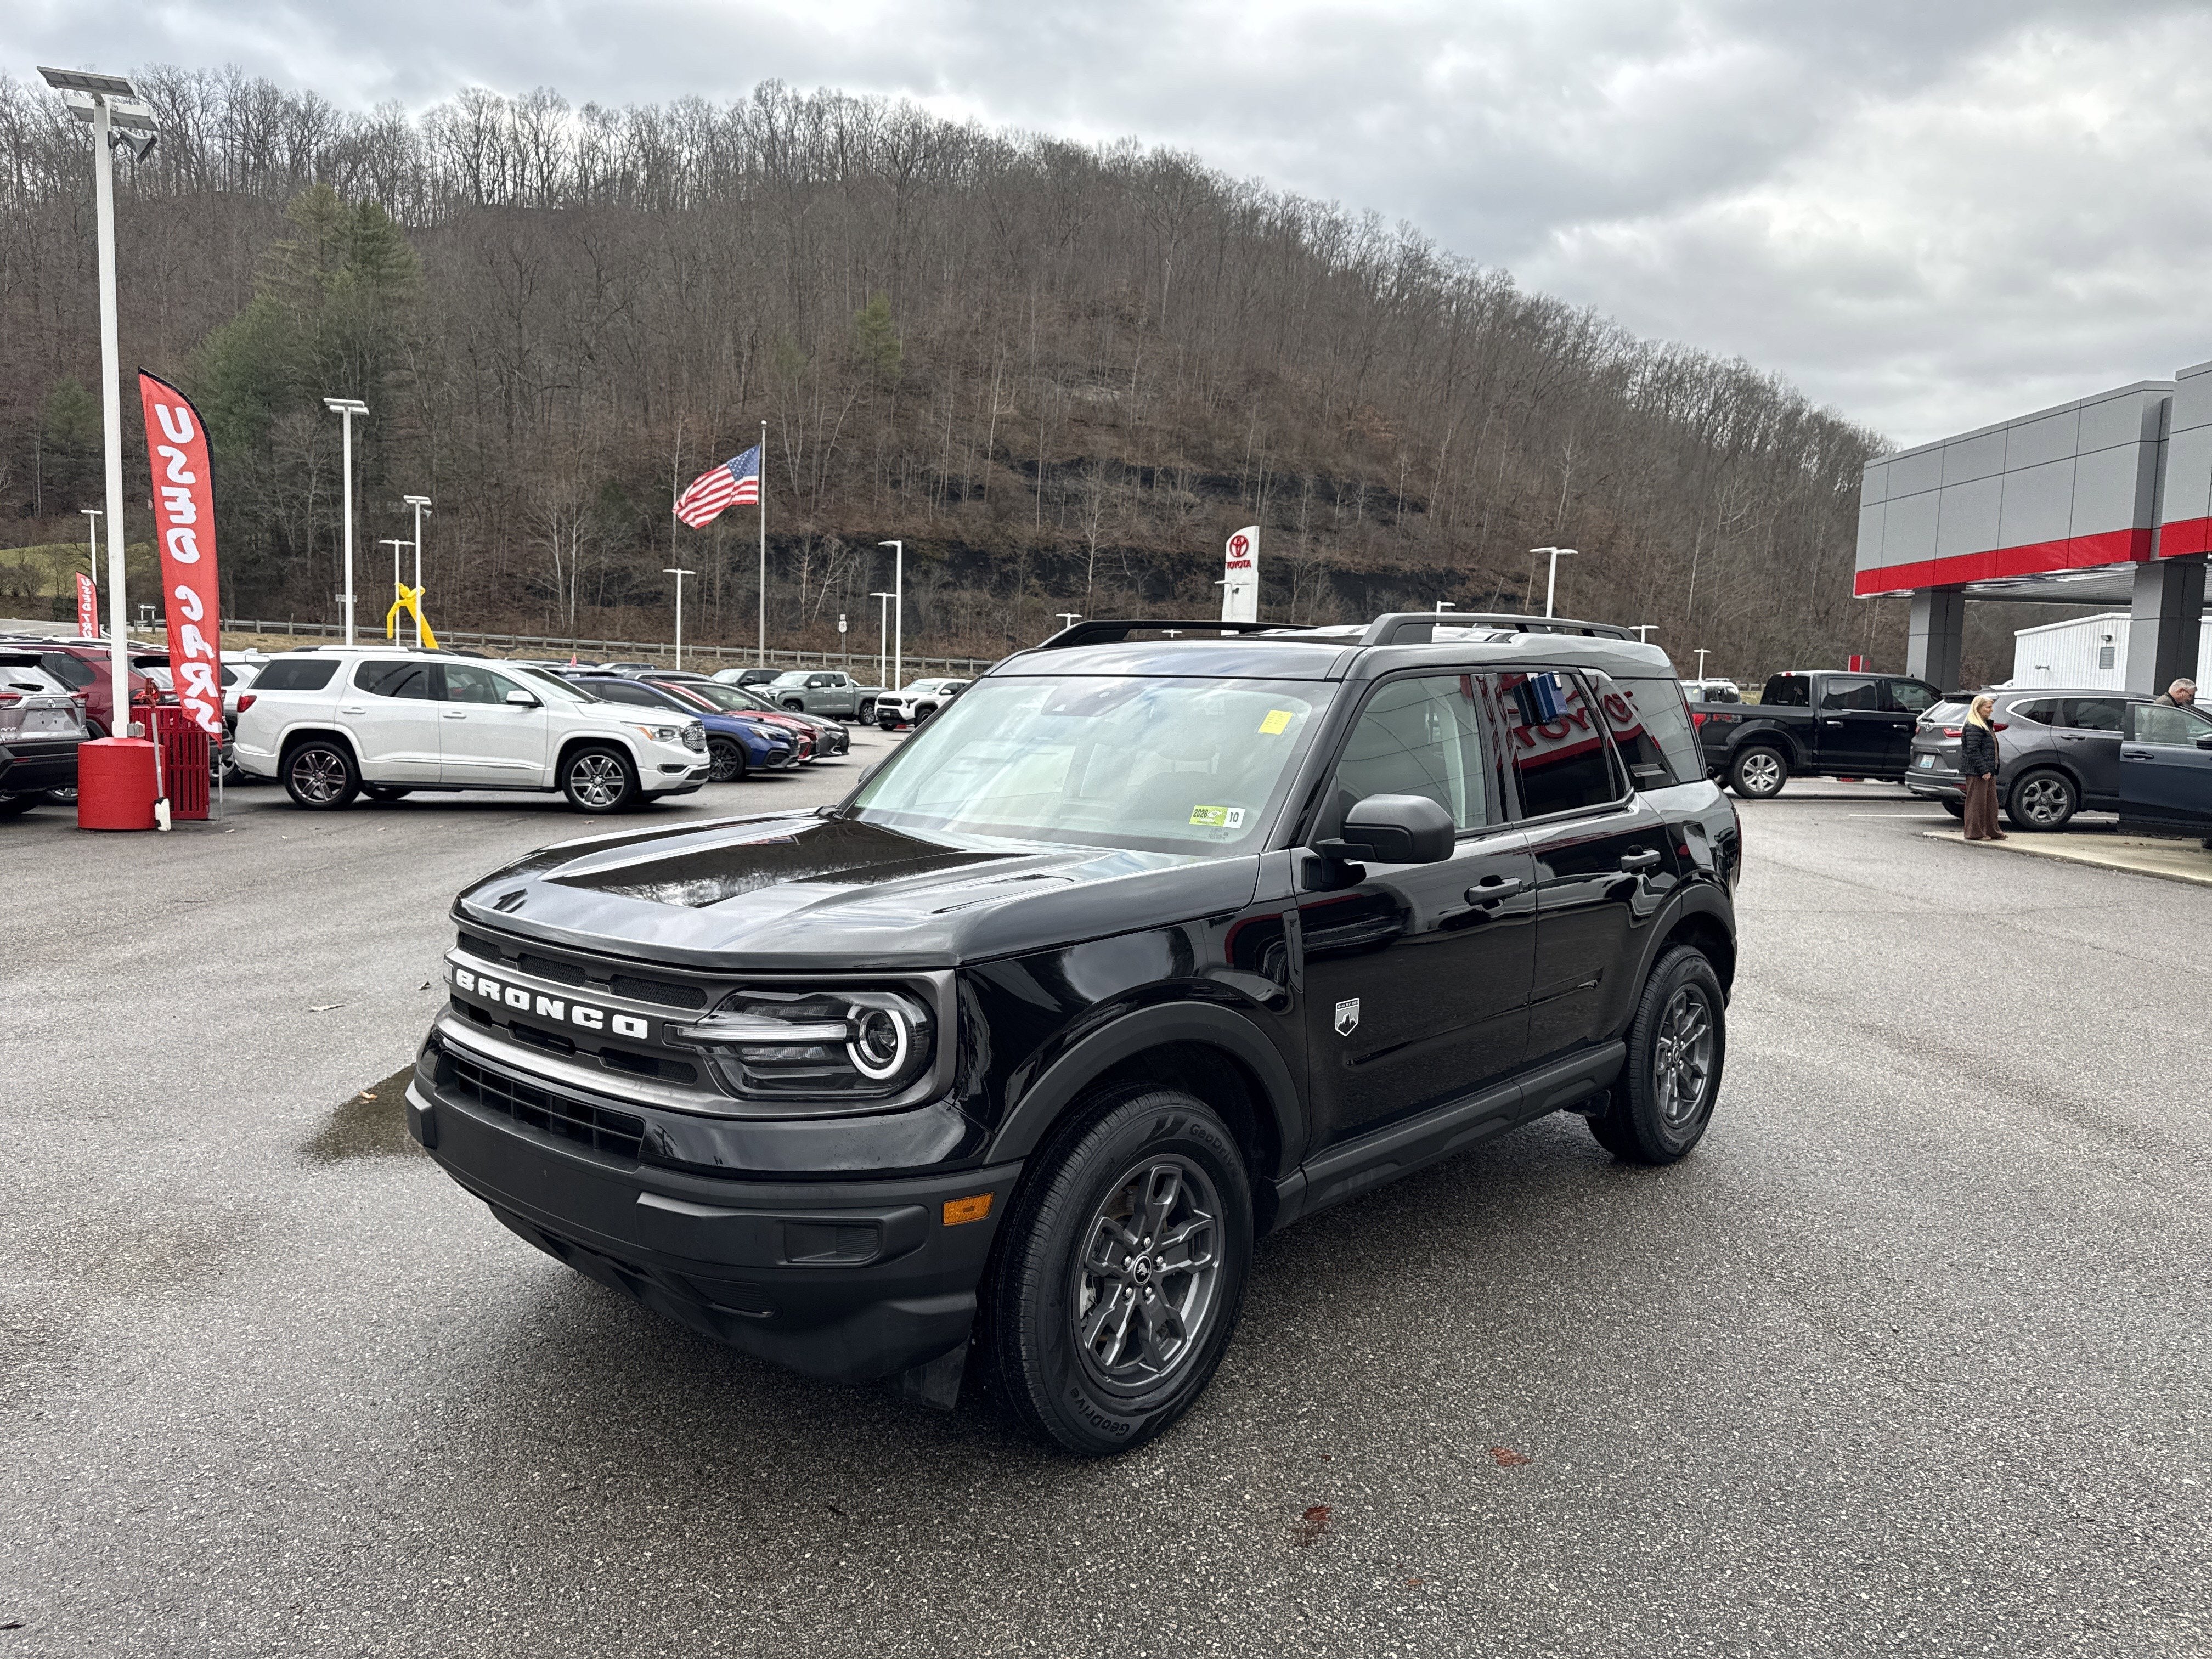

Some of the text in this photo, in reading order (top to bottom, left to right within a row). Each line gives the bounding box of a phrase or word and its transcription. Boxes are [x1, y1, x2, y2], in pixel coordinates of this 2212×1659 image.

[1226, 560, 1251, 571] TOYOTA
[1193, 809, 1208, 818] 2026
[1229, 811, 1239, 822] 10
[456, 968, 648, 1039] BRONCO
[1189, 1124, 1239, 1177] GeoDrive
[1070, 1387, 1130, 1436] GeoDrive
